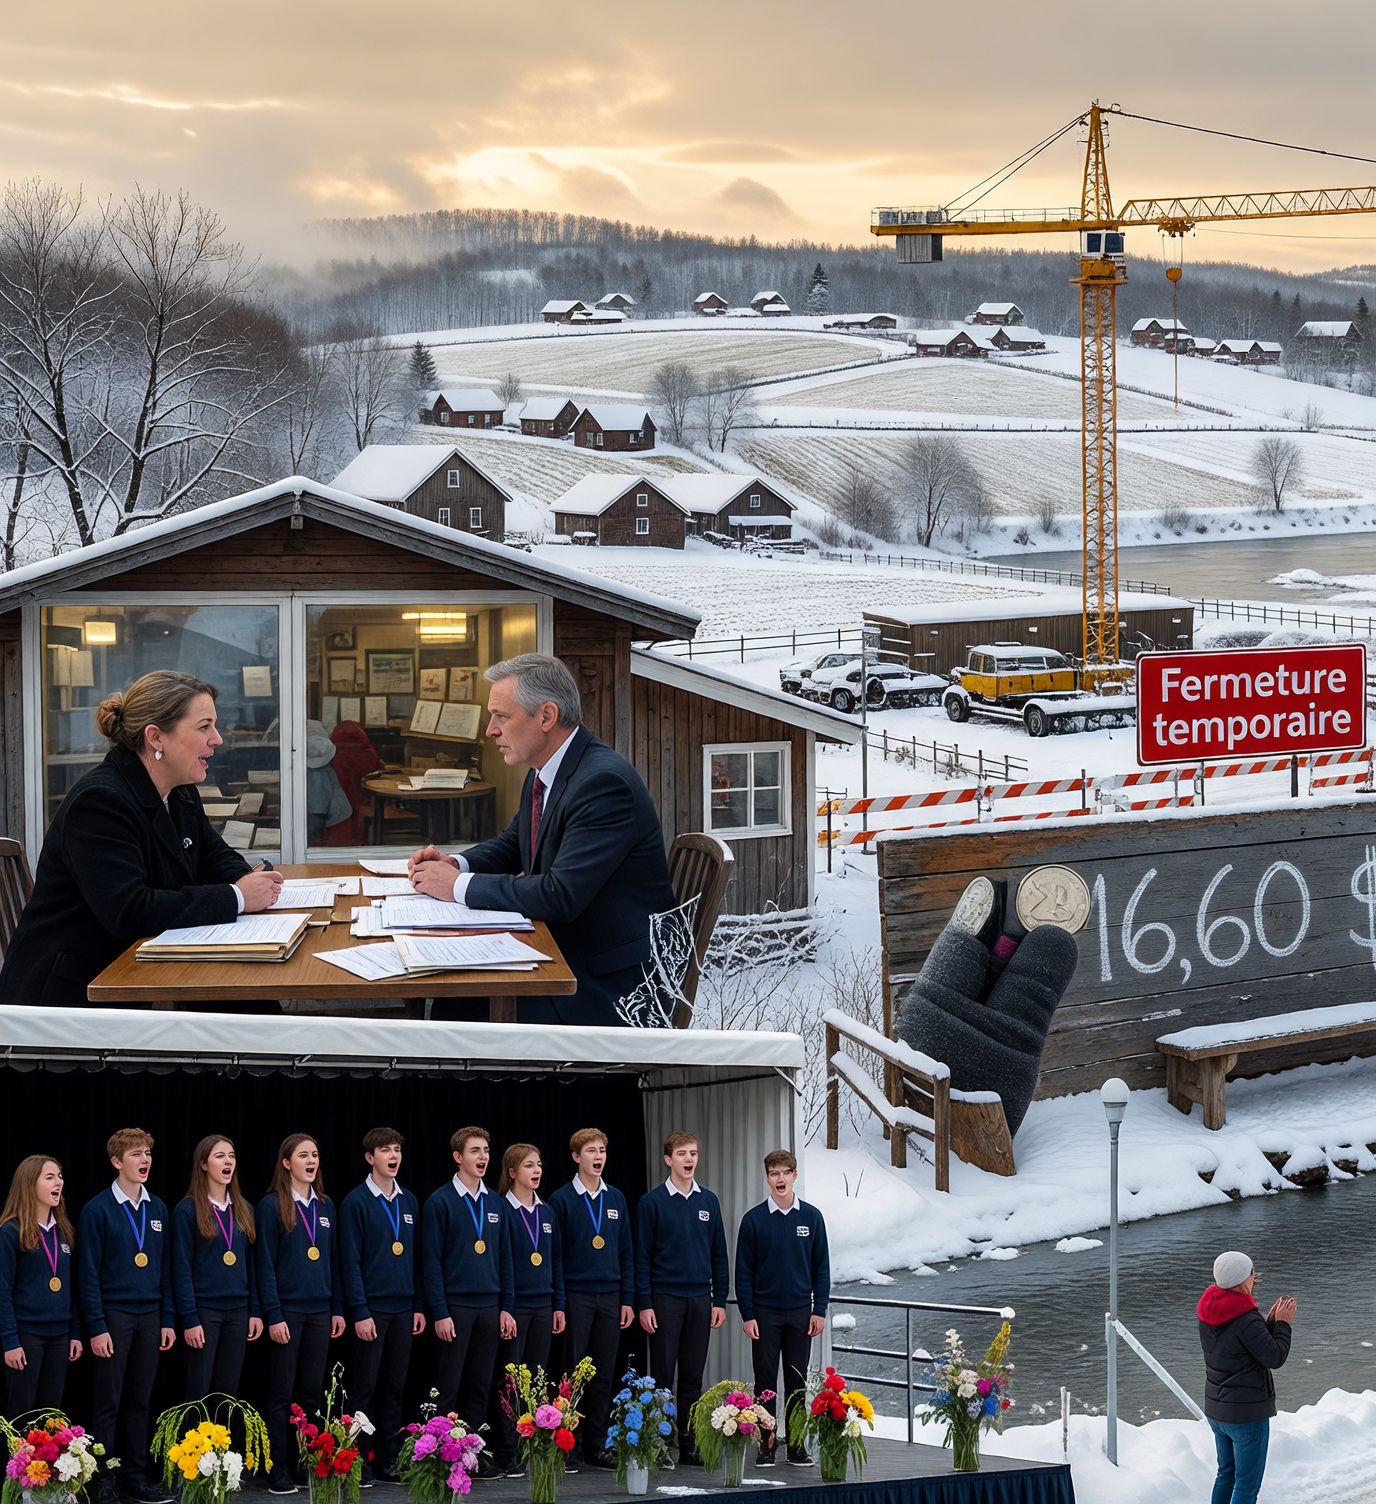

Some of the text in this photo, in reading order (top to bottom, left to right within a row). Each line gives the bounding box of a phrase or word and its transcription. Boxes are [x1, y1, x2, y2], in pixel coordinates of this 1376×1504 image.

[1161, 664, 1347, 703] Fermeture
[1152, 702, 1351, 750] temporaire
[1092, 860, 1311, 984] 16,60
